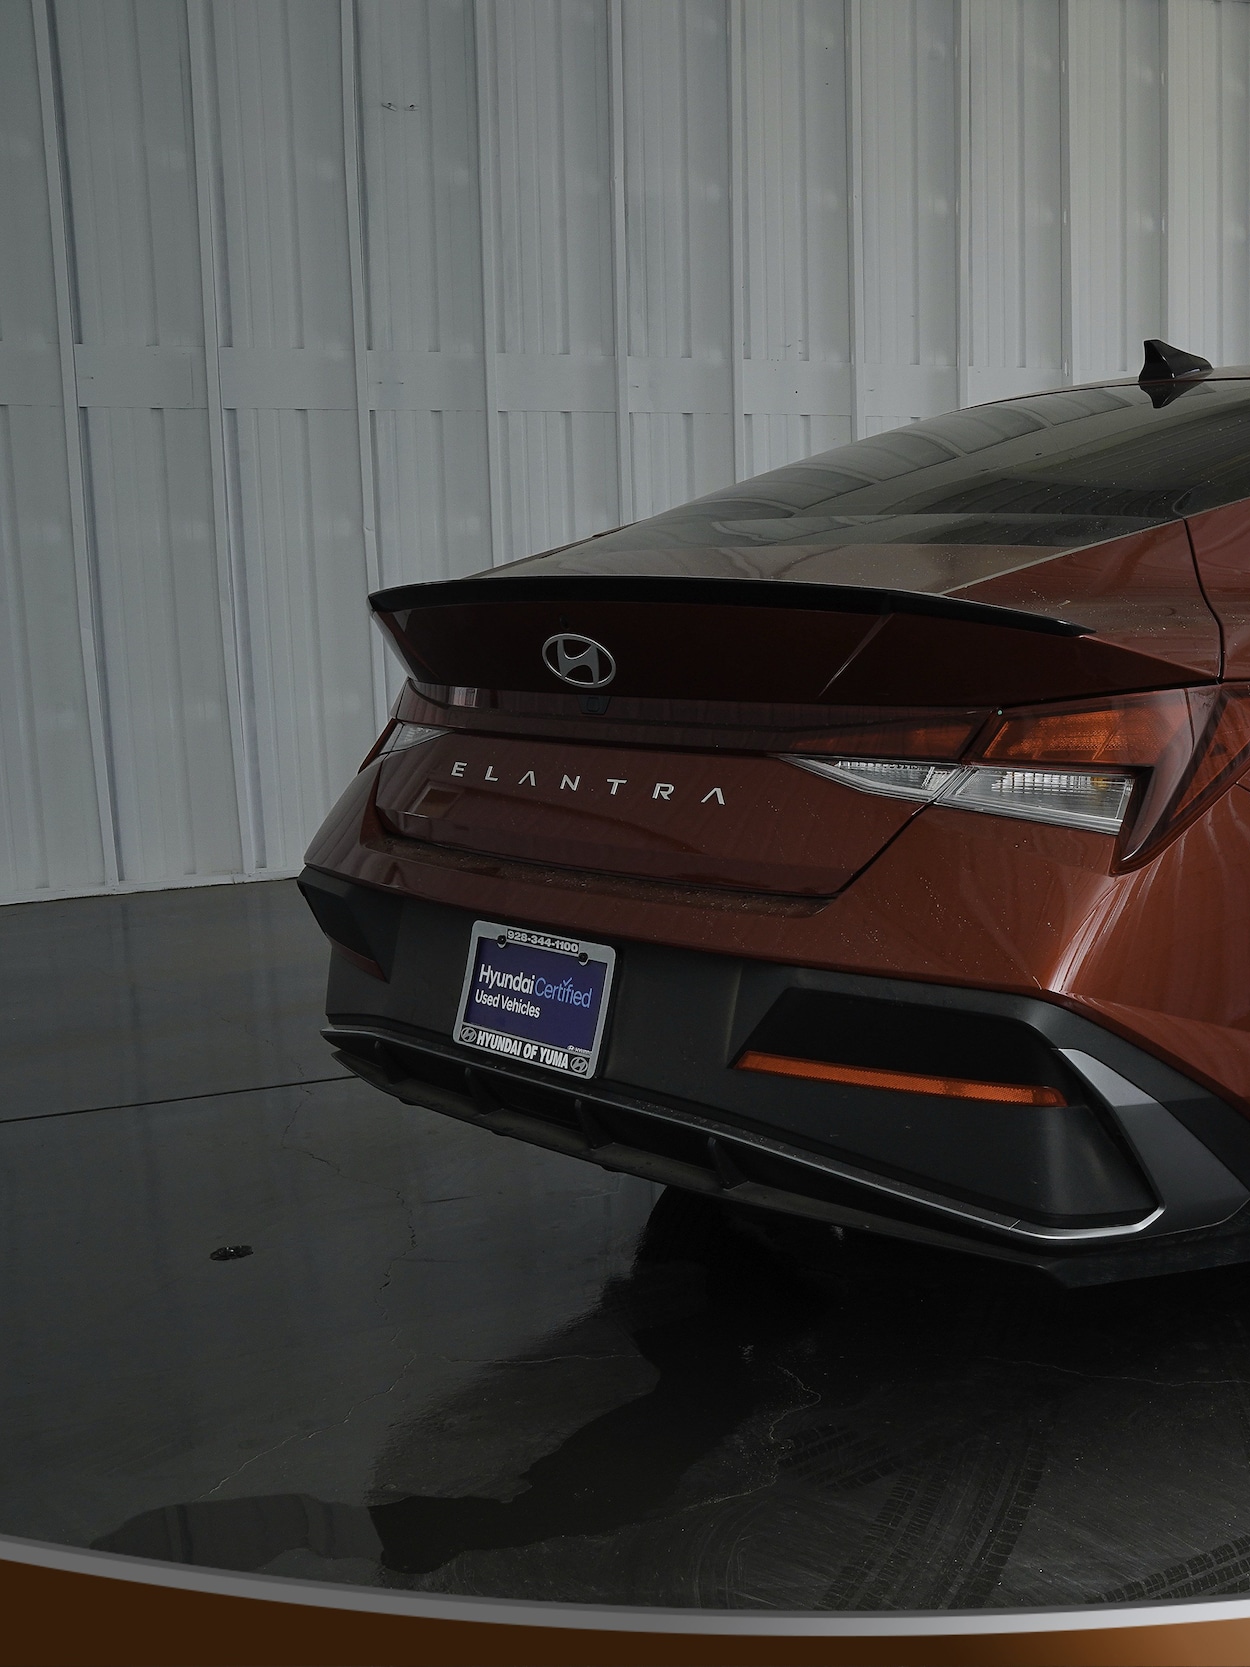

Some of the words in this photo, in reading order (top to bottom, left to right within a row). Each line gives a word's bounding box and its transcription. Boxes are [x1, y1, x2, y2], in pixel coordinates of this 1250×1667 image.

[450, 760, 726, 805] ELANTRA
[506, 929, 579, 953] 928-344-1100
[475, 988, 500, 1009] Used
[500, 995, 541, 1019] Vehicles
[478, 963, 535, 995] Hyundai
[534, 977, 593, 1009] Certified
[476, 1030, 523, 1057] HYUNDAI
[523, 1043, 538, 1060] OF
[539, 1047, 569, 1070] YUMA
